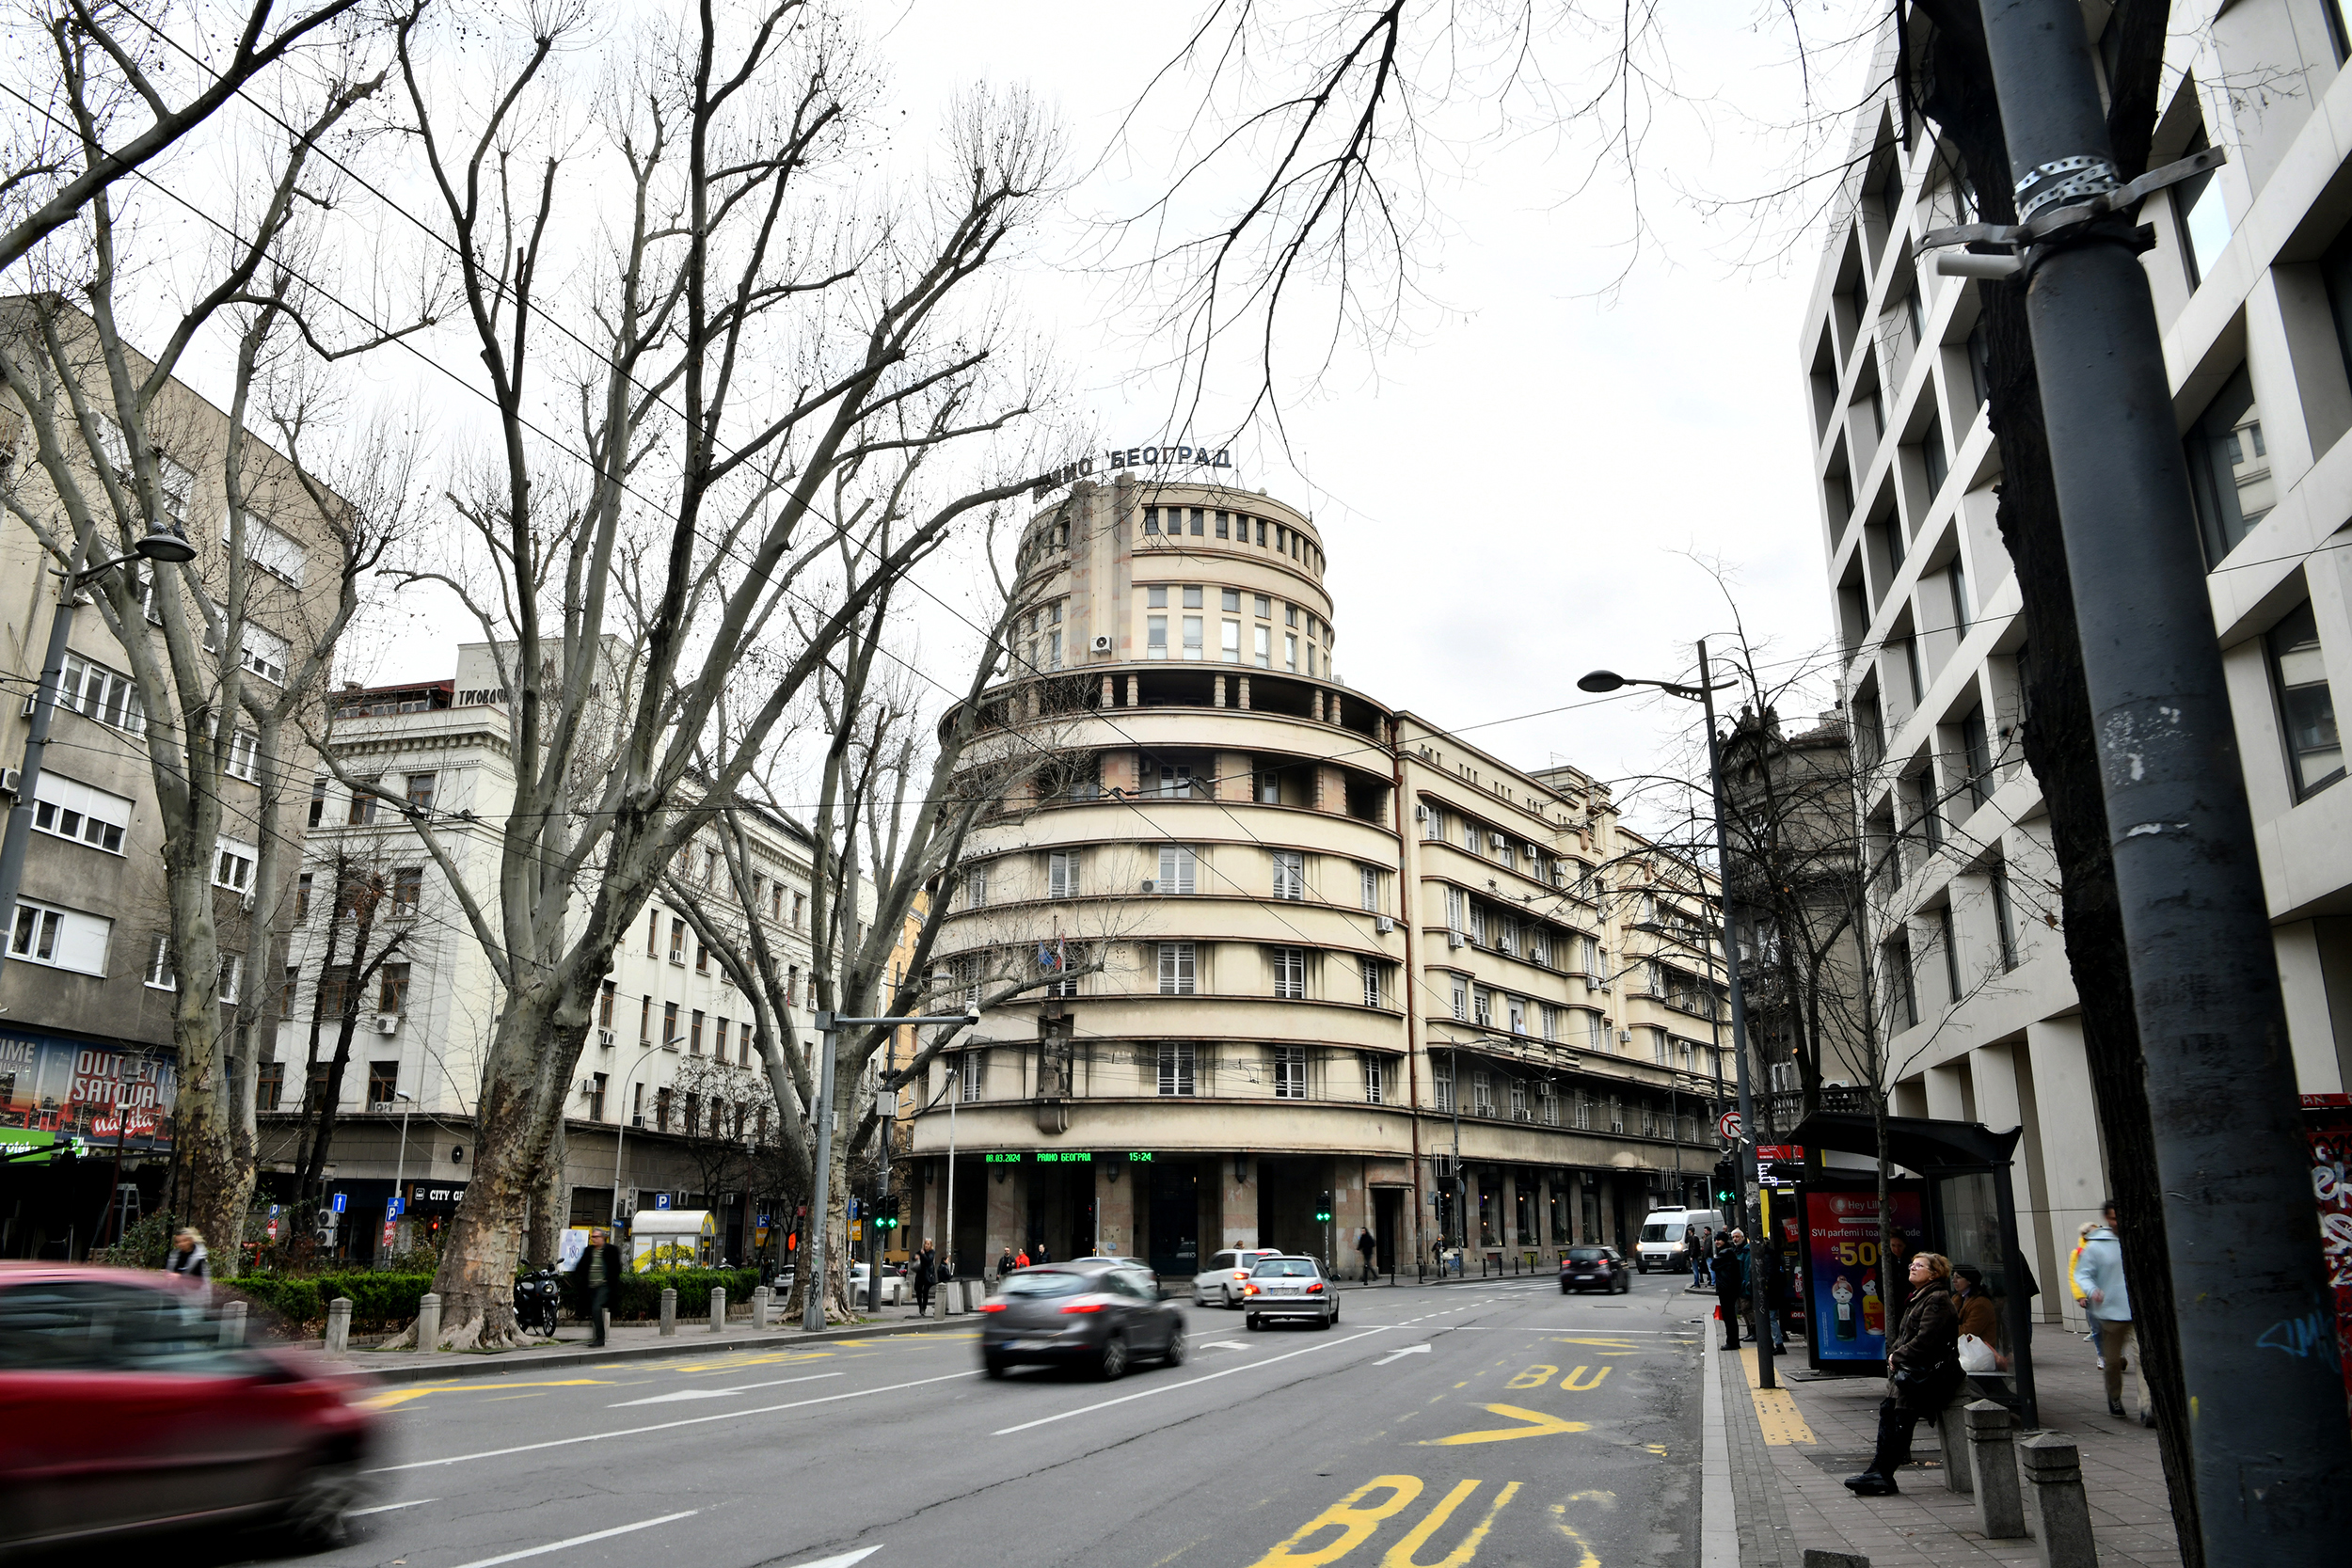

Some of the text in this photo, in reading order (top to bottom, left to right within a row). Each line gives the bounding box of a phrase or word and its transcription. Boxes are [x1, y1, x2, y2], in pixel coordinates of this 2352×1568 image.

[1111, 446, 1232, 468] БЕОГРАД
[0, 1038, 36, 1064] IME
[77, 1050, 163, 1084] OUTET
[986, 1153, 1021, 1163] 08.03.2024
[1060, 1152, 1091, 1162] БЕОГРАД
[1129, 1152, 1152, 1162] 15:24
[429, 1189, 450, 1201] CITY
[659, 1196, 667, 1207] P
[1848, 1200, 1865, 1212] Hey
[388, 1207, 396, 1221] P
[1811, 1228, 1826, 1237] SVI
[1827, 1227, 1860, 1238] parfemi
[1904, 1227, 1921, 1237] ode
